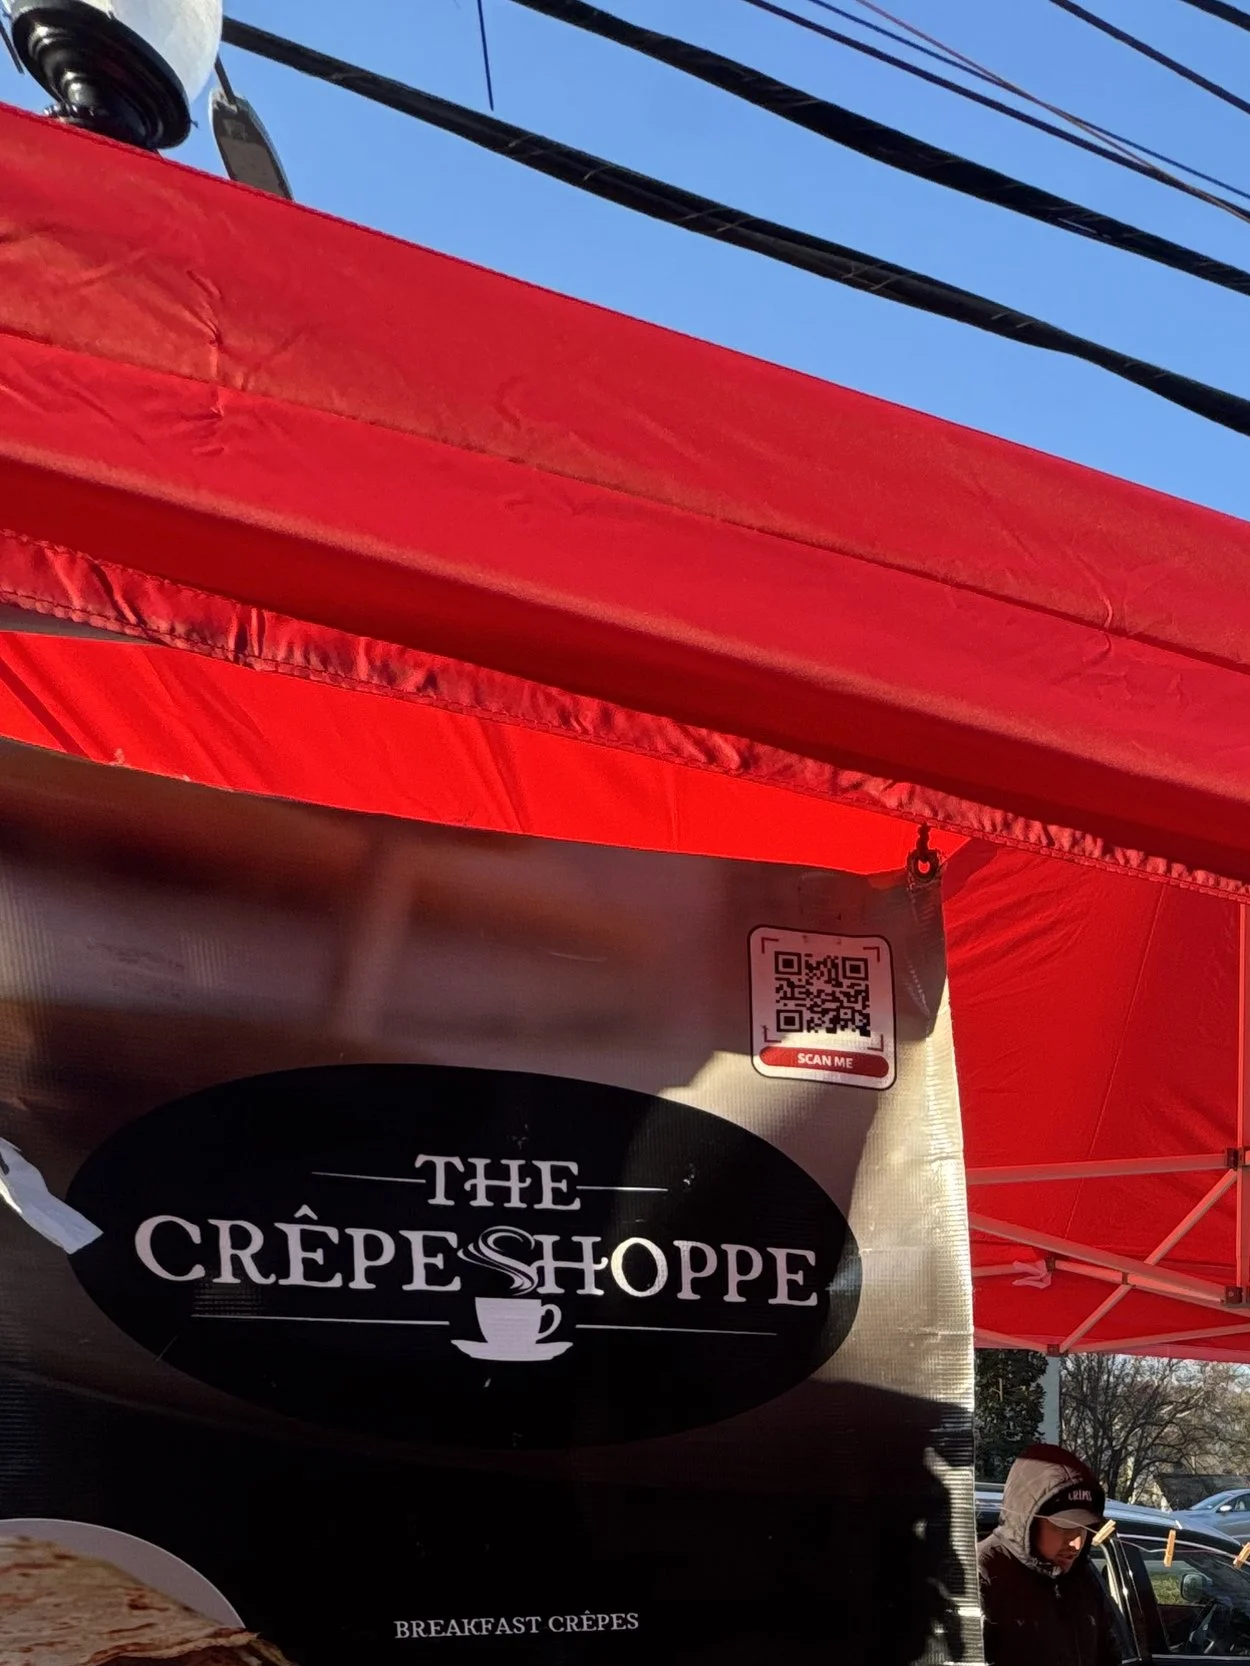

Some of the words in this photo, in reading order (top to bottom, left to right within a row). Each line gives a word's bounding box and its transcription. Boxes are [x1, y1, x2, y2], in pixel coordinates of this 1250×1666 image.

[797, 1053, 832, 1066] SCAN
[834, 1056, 853, 1069] ME
[414, 1153, 581, 1210] THE
[134, 1203, 464, 1293] CRÊPE
[456, 1224, 819, 1308] SHOPPE
[394, 1616, 542, 1639] BREAKFAST
[547, 1610, 640, 1633] CRÊPES
